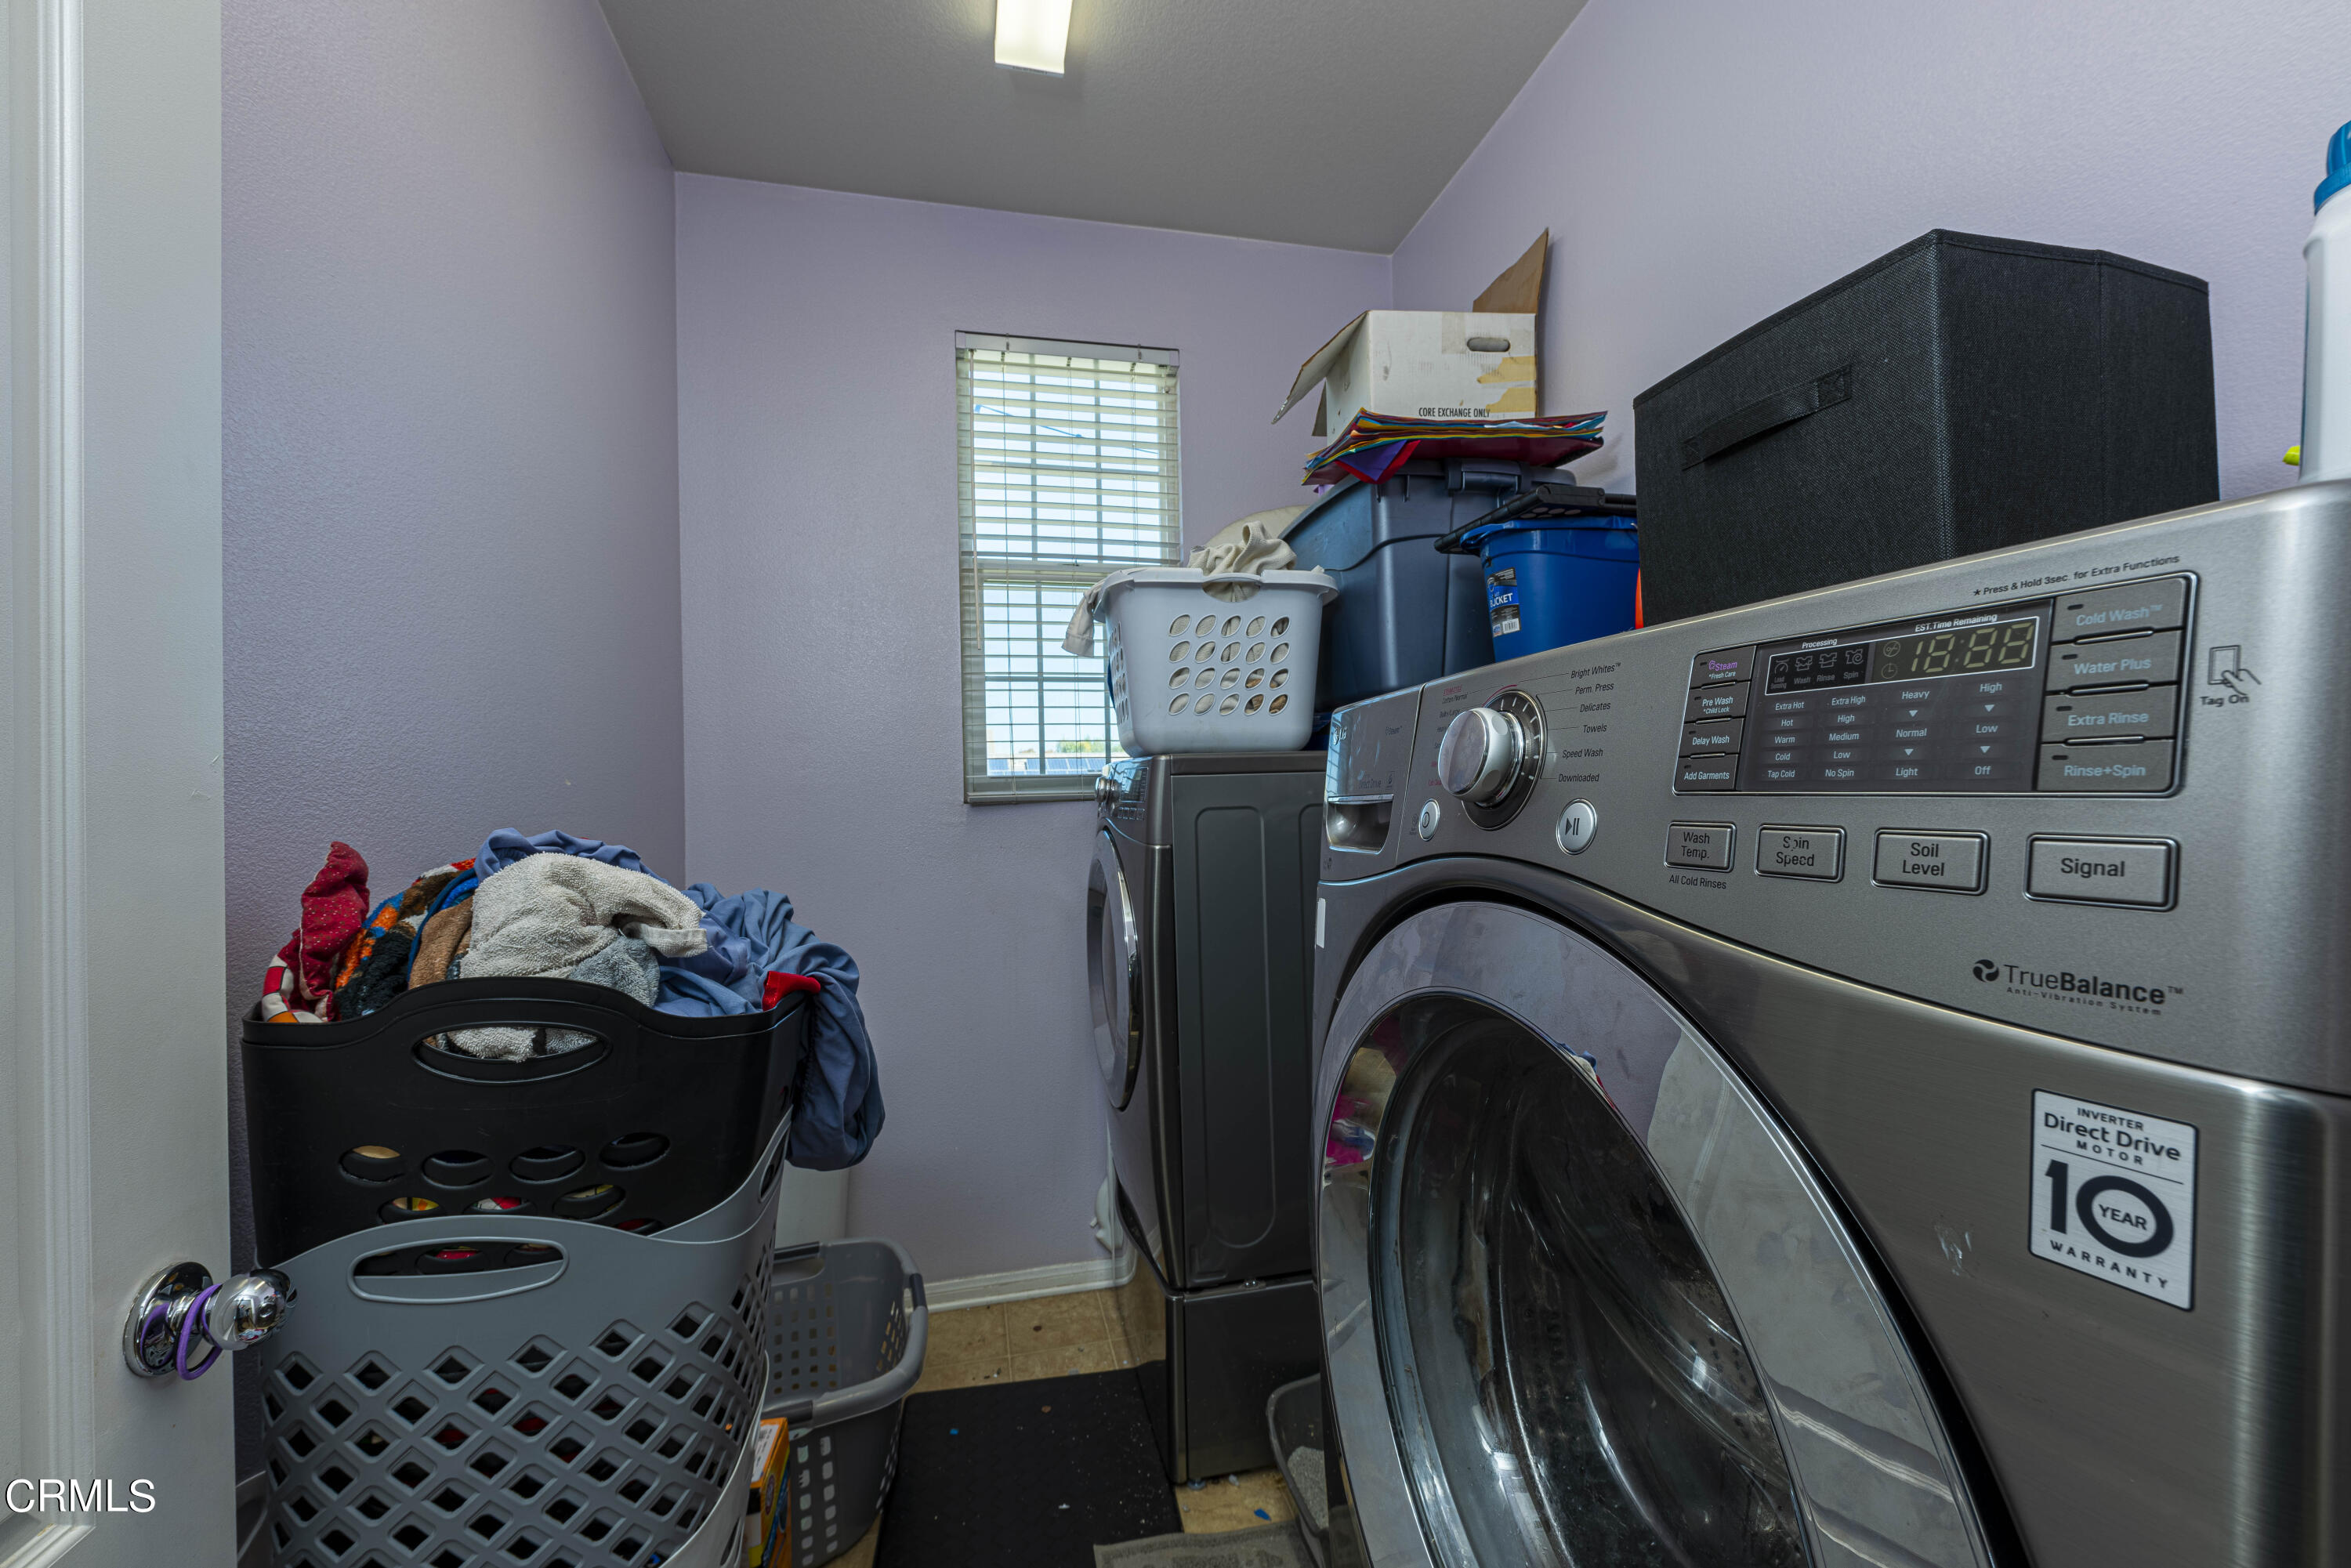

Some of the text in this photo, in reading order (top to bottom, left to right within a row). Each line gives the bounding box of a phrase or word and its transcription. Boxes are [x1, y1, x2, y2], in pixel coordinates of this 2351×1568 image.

[1418, 407, 1491, 418] CORE EXCHANGE ONLY
[1983, 585, 2009, 596] Press
[2020, 578, 2042, 588] Hold
[2074, 571, 2089, 580] for
[2091, 565, 2120, 577] Extra
[2123, 556, 2180, 572] Functions
[1954, 614, 1998, 627] Remaining
[2077, 613, 2105, 626] Cold
[1802, 639, 1837, 649] Processing
[1715, 661, 1737, 671] Steam
[2074, 658, 2151, 675] Water Plus
[1571, 668, 1590, 679] Bright
[1575, 683, 1614, 695] Perm. Press
[1980, 683, 2002, 693] High
[1831, 695, 1866, 706] Extra High
[1902, 690, 1930, 700] Heavy
[1702, 696, 1733, 707] Pre Wash
[1791, 701, 1804, 709] Hot
[2200, 694, 2249, 708] Tag On
[1580, 702, 1610, 712] Delicates
[1781, 719, 1794, 727] Hot
[1838, 714, 1855, 723] High
[2067, 712, 2149, 726] Extra Rinse
[1339, 726, 1348, 741] LG
[1583, 723, 1607, 733] Towels
[1896, 729, 1927, 737] Normal
[1976, 725, 1998, 733] Low
[1693, 735, 1730, 746] Delay Wash
[1774, 735, 1795, 744] Warm
[1829, 732, 1859, 741] Medium
[1563, 748, 1603, 759] Speed Wash
[1775, 752, 1790, 761] Cold
[1834, 751, 1850, 759] Low
[1684, 771, 1730, 780] Add Garments
[1768, 770, 1780, 779] Tap
[1837, 769, 1854, 779] Spin
[1896, 768, 1918, 777] Light
[1974, 766, 1991, 775] Off
[2063, 765, 2146, 778] Rinse+Spin
[1559, 773, 1599, 782] Downloaded
[1683, 831, 1710, 845] Wash
[1681, 846, 1710, 860] Temp.
[1910, 842, 1939, 858] Soil
[1776, 851, 1815, 867] Speed
[1902, 860, 1945, 877] Level
[2060, 857, 2125, 879] Signal
[1668, 875, 1726, 890] All Cold Rinses
[2006, 987, 2161, 1016] Anti-Vibration System
[2077, 1106, 2144, 1131] INVERTER
[2044, 1112, 2181, 1161] Direct Drive
[2077, 1140, 2143, 1165] MOTOR
[2045, 1159, 2174, 1258] 10
[2098, 1204, 2147, 1230] YEAR
[2050, 1240, 2168, 1289] WARRANTY
